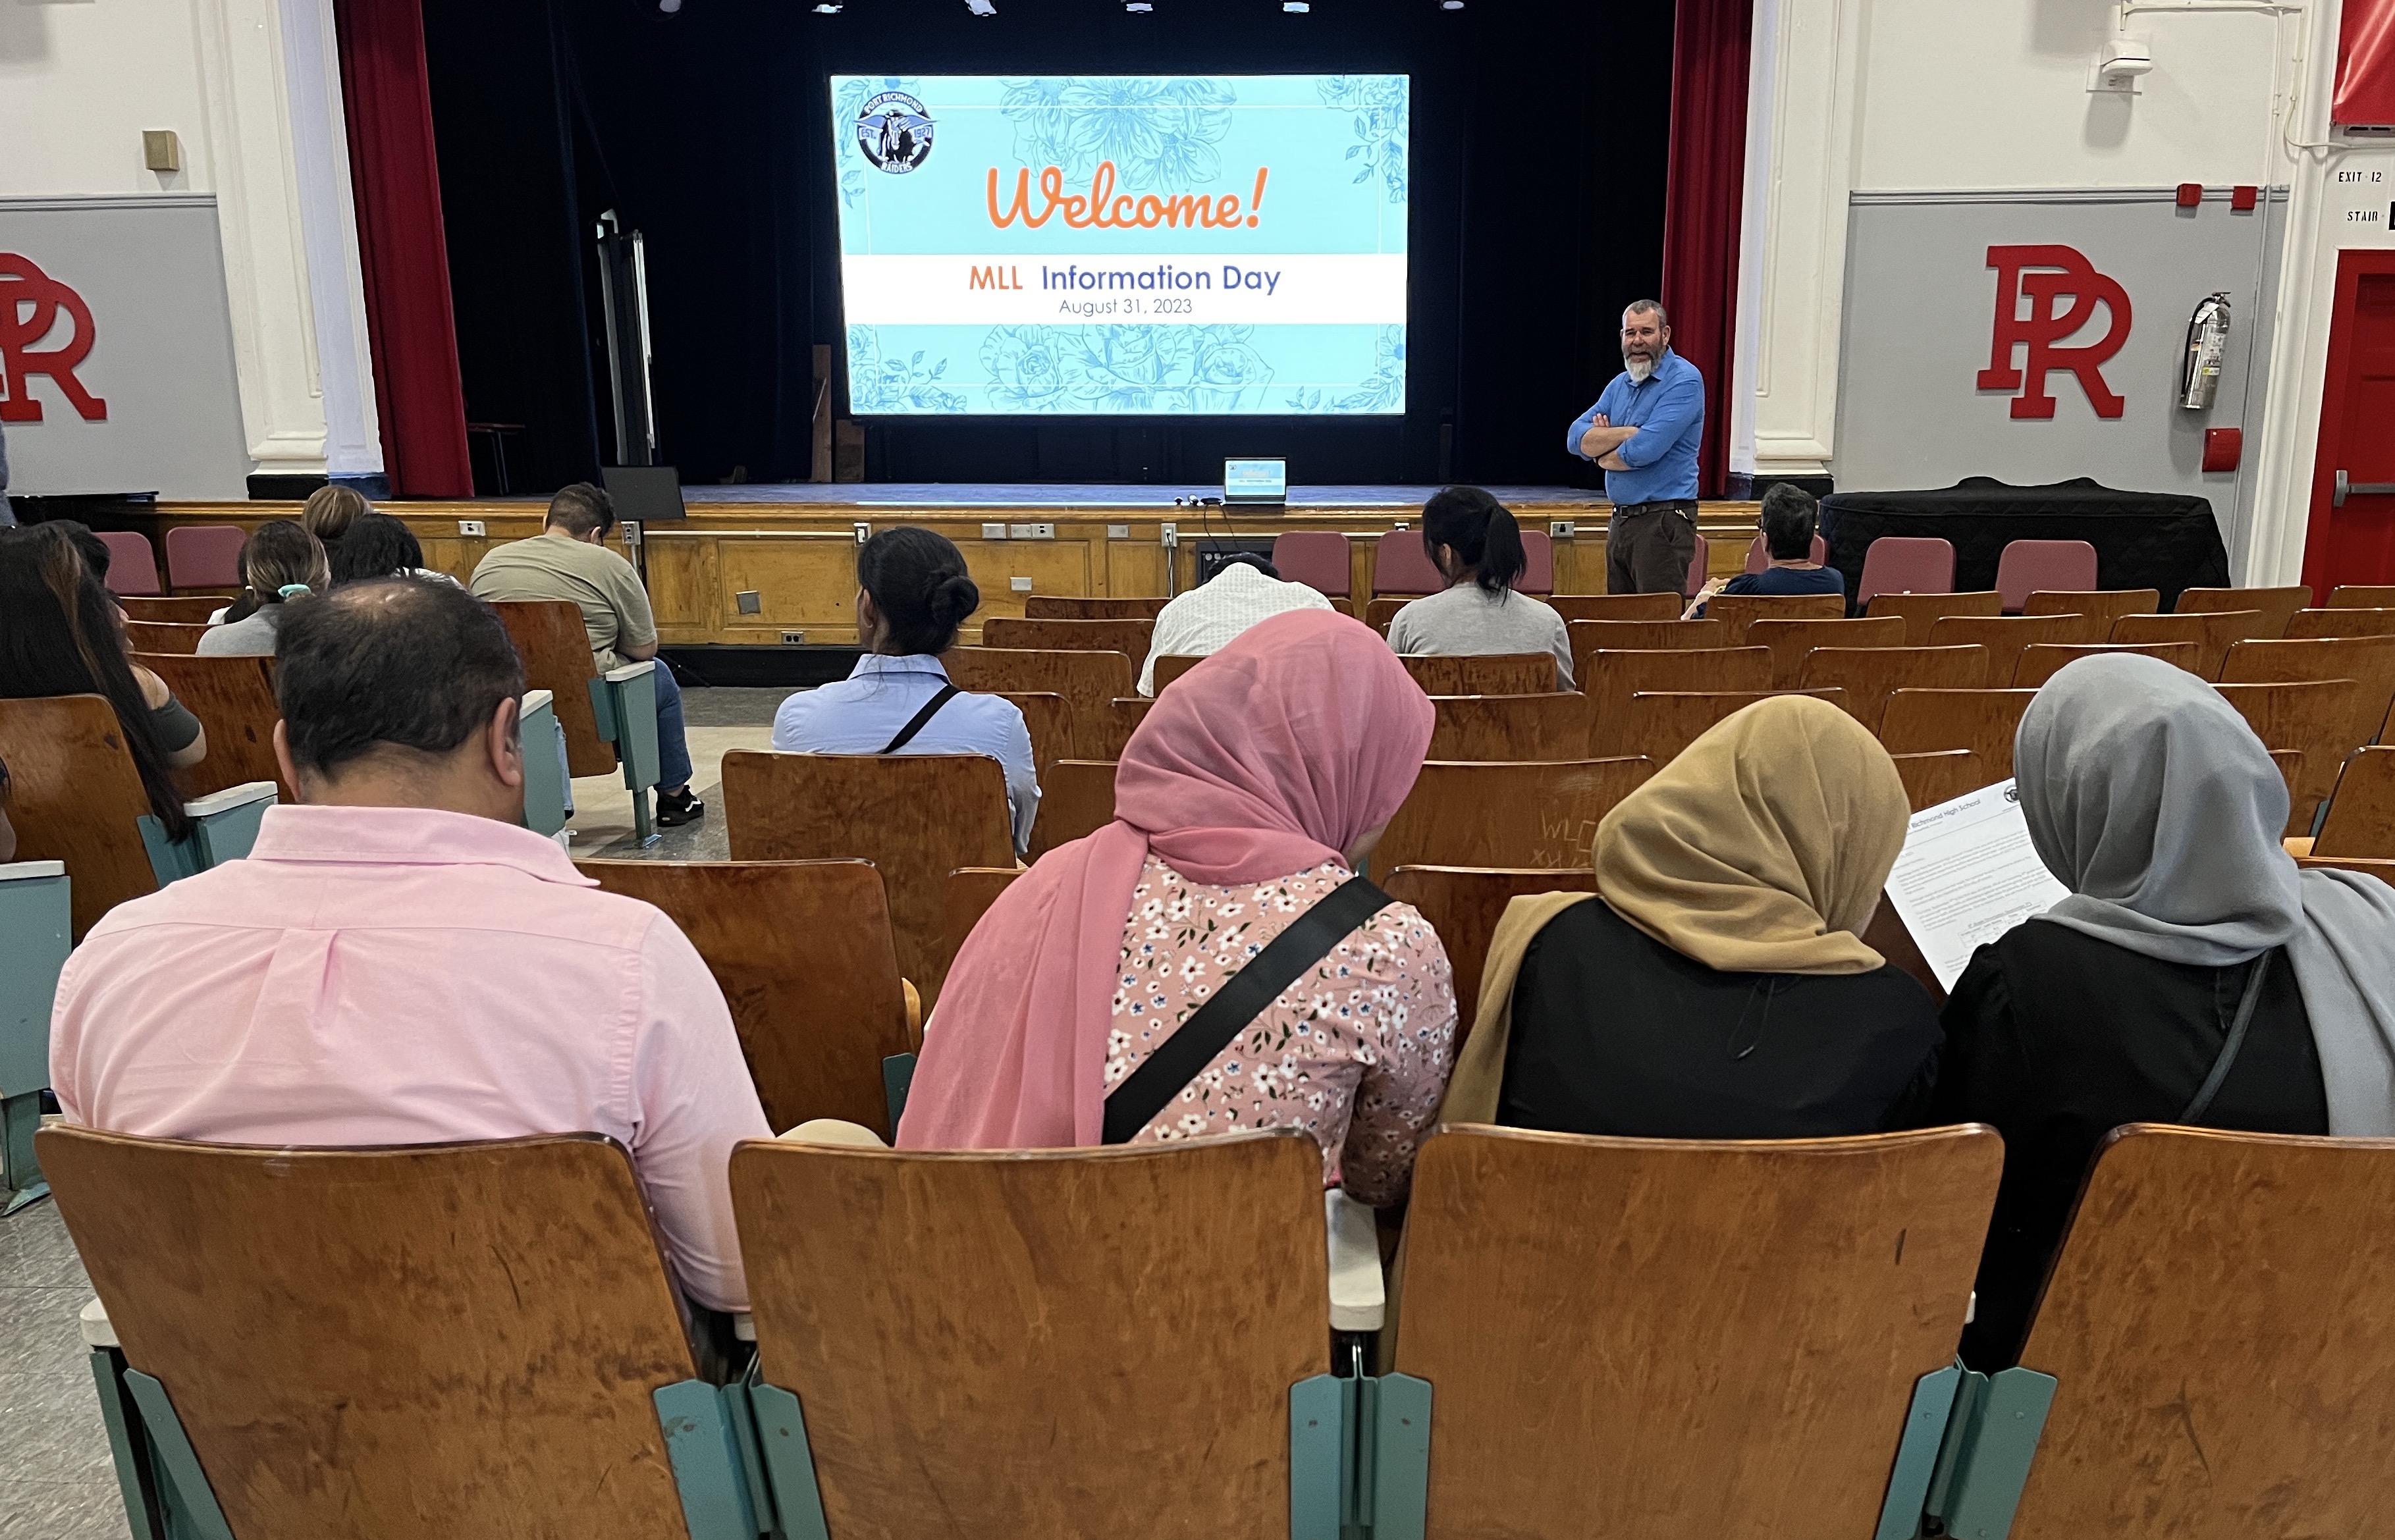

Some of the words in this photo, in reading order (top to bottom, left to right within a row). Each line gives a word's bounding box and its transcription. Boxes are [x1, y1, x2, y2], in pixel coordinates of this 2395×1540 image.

[864, 95, 883, 115] PORT
[882, 92, 923, 113] RICHMOND
[861, 128, 876, 140] EST.
[914, 127, 930, 138] 1927
[881, 161, 913, 173] RAIDERS
[2338, 171, 2362, 182] EXIT
[2371, 171, 2382, 182] 12
[986, 160, 1269, 229] Welcome!
[2347, 211, 2378, 222] STAIR
[969, 265, 1023, 290] MLL
[1042, 265, 1211, 290] Information
[1223, 265, 1281, 296] Day
[1059, 299, 1117, 317] August
[1123, 299, 1148, 315] 31,
[1153, 299, 1193, 314] 2023
[1911, 812, 1943, 828] Richmond
[1943, 807, 1960, 817] High
[1958, 799, 1981, 812] School
